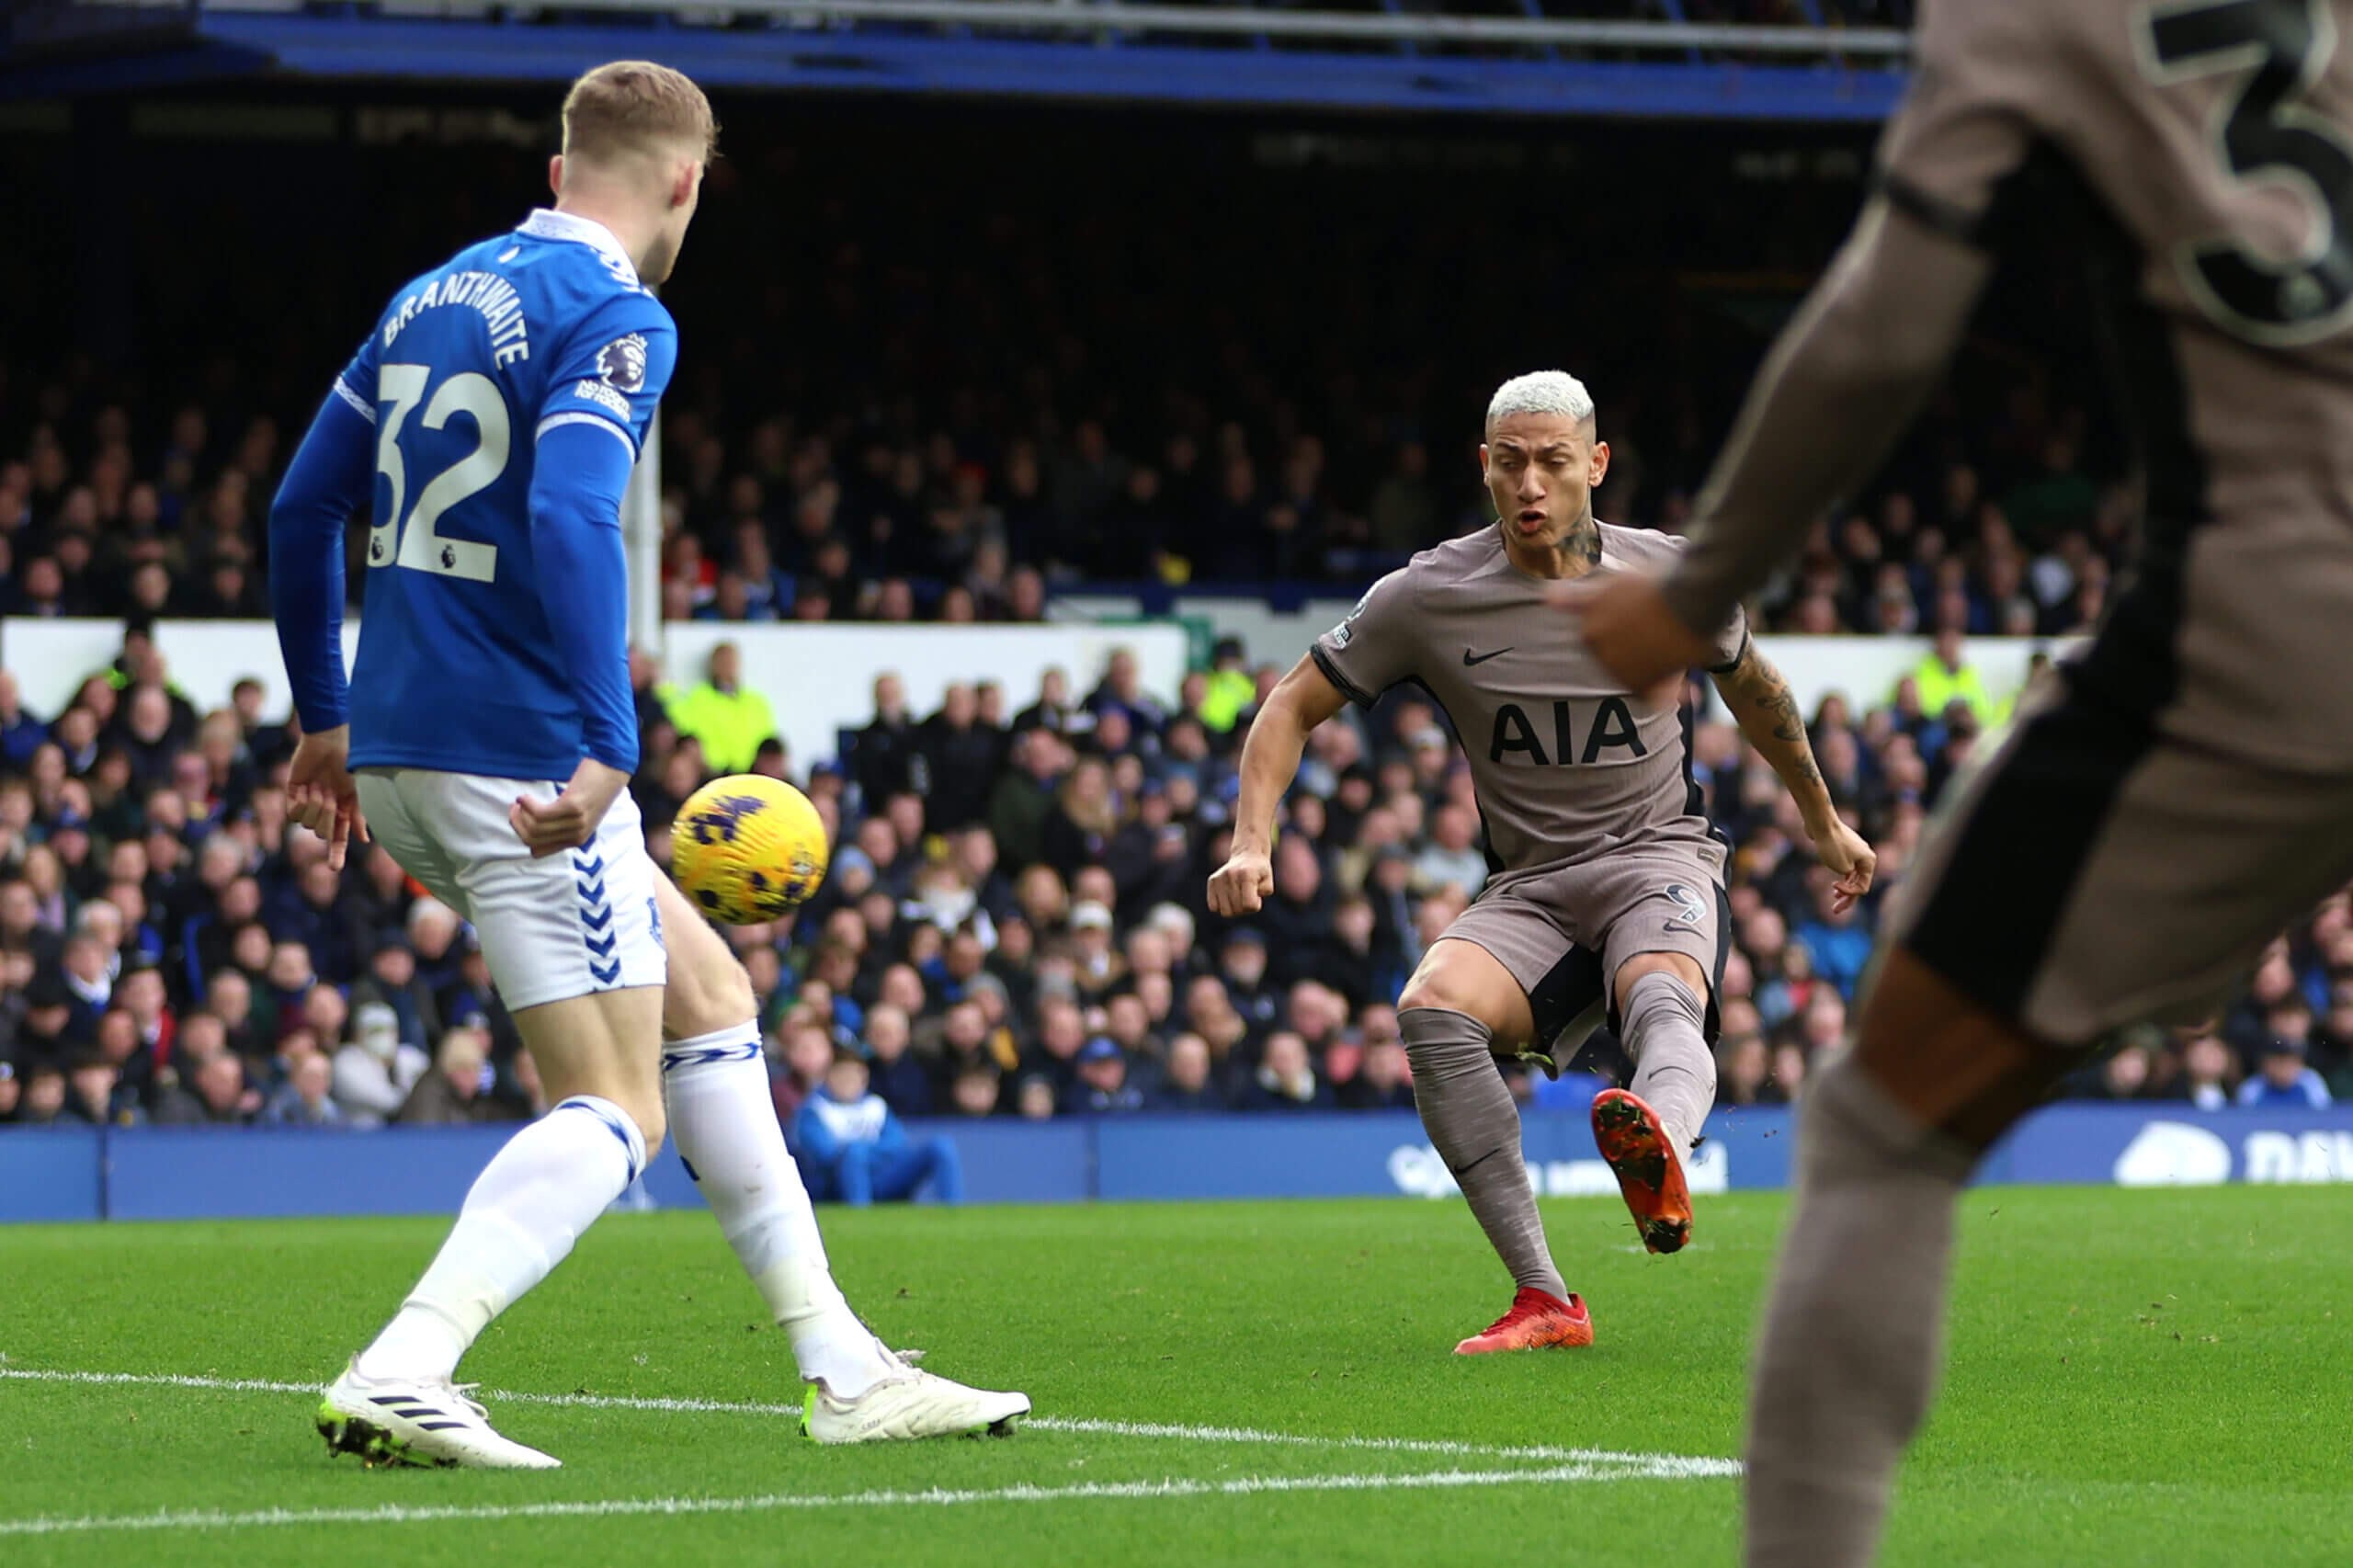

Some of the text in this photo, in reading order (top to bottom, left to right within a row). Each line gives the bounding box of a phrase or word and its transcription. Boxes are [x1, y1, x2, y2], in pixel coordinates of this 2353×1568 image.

[384, 271, 529, 370] BRANTHWAITE
[367, 364, 511, 584] 32
[1490, 697, 1648, 766] AIA
[1665, 883, 1707, 925] 9
